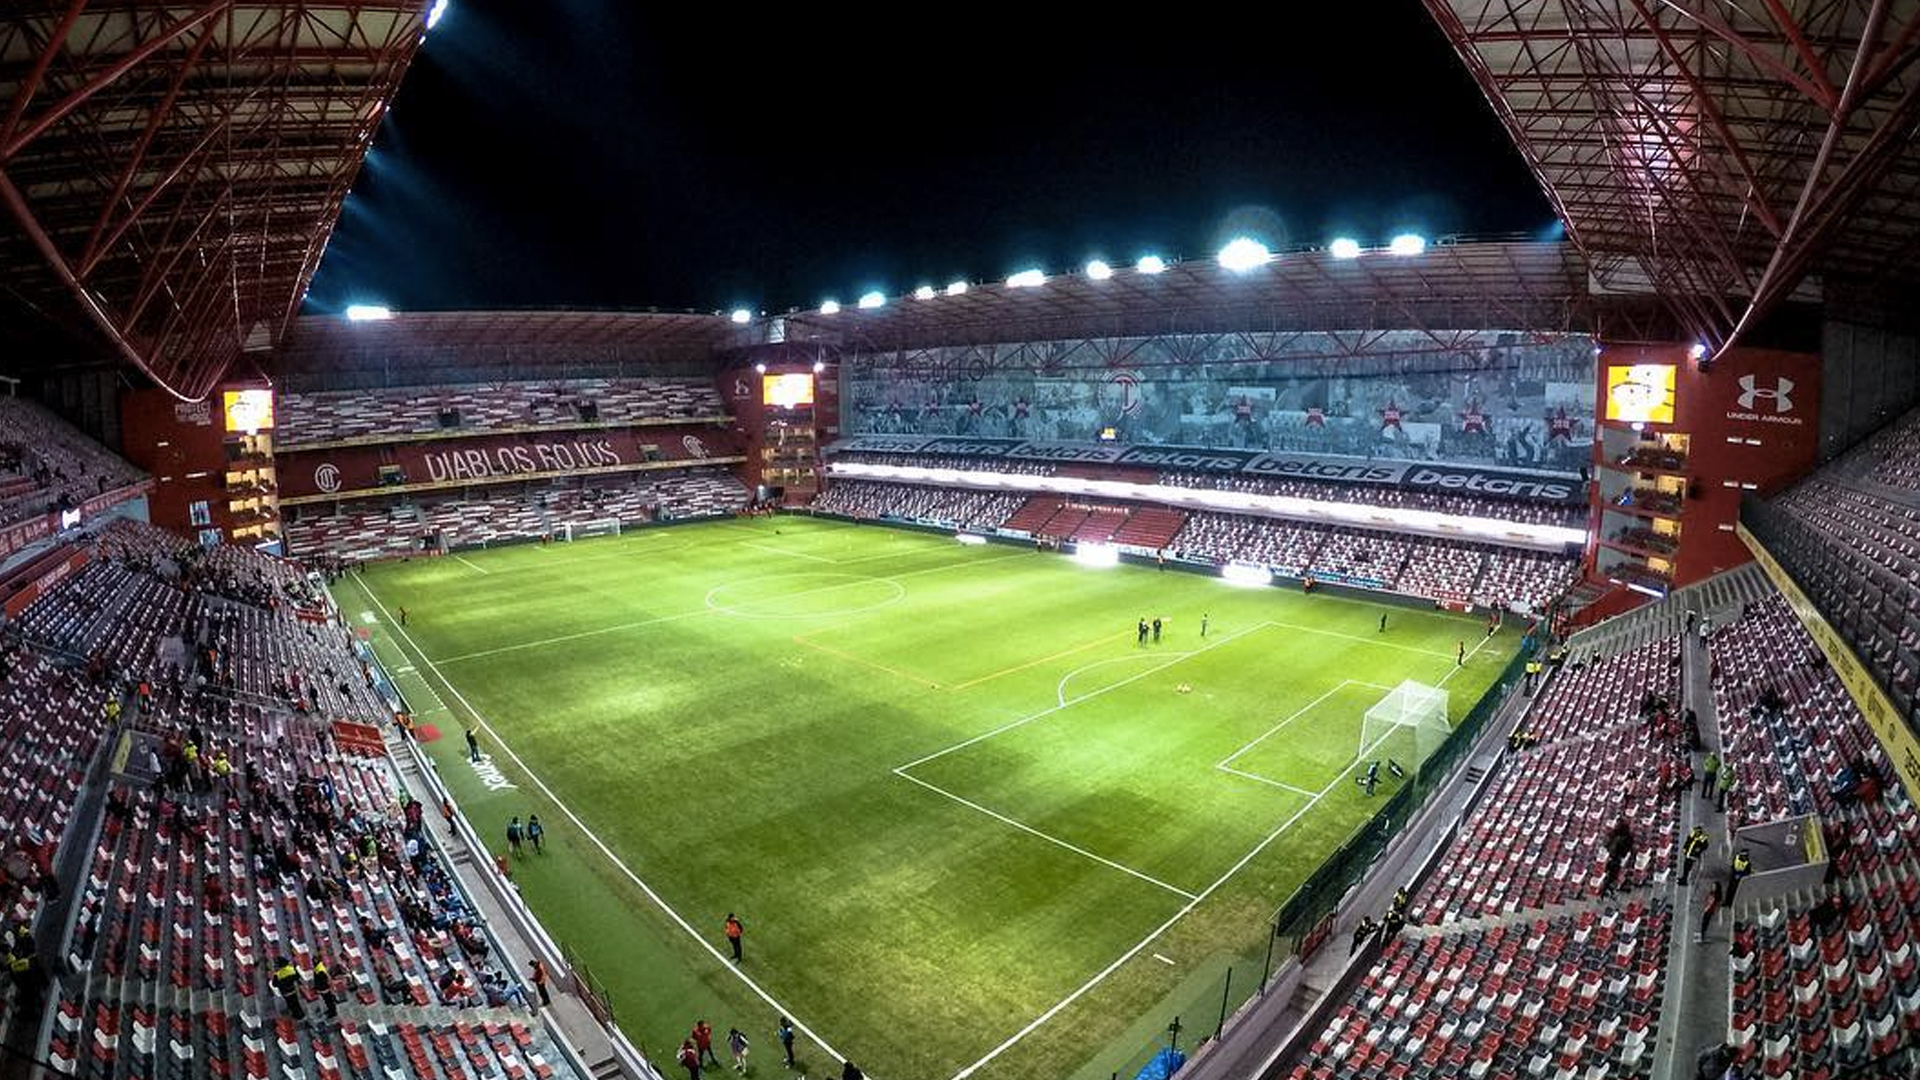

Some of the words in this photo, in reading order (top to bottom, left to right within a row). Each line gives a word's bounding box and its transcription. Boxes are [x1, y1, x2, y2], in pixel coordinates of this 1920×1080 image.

[1726, 411, 1759, 421] UNDER
[1761, 414, 1802, 425] ARMOUR
[424, 446, 535, 482] DIABLOS
[535, 441, 621, 470] ROJOS
[1012, 444, 1113, 463] betcris
[1122, 449, 1243, 470] betcris
[1255, 457, 1395, 480] betcris
[1411, 468, 1571, 500] betcris
